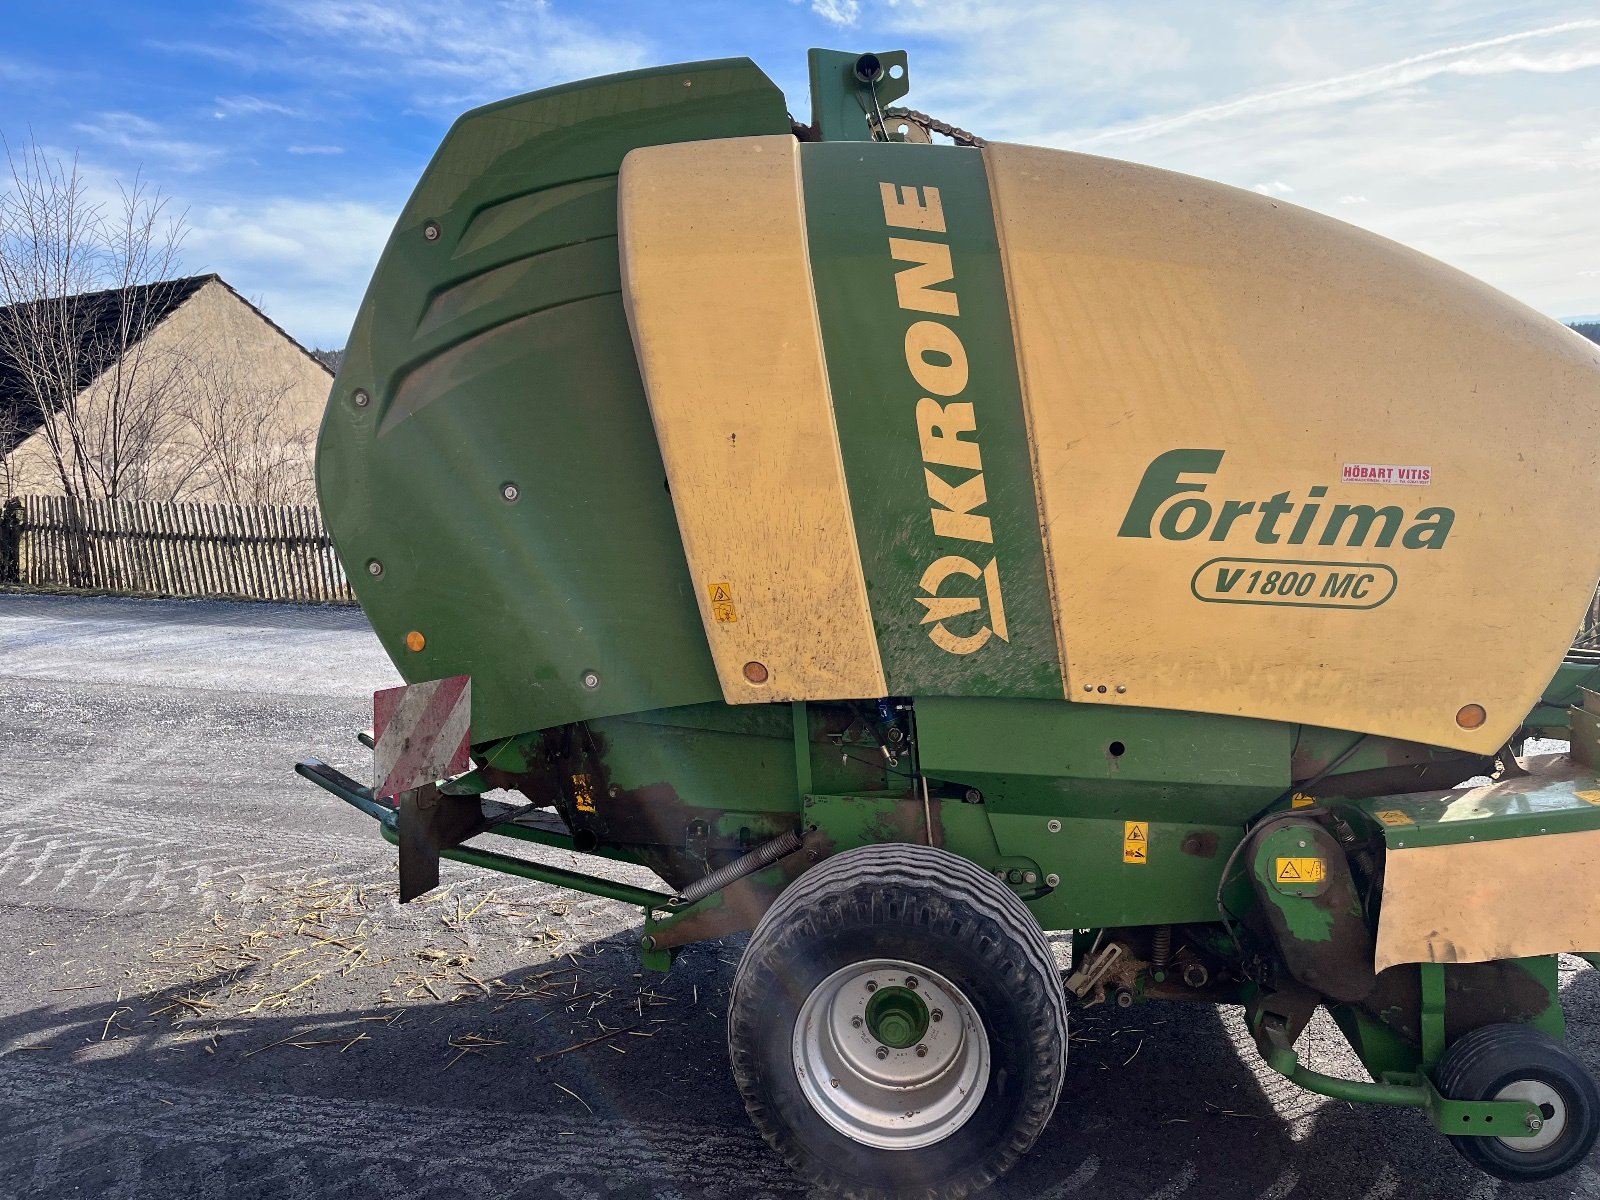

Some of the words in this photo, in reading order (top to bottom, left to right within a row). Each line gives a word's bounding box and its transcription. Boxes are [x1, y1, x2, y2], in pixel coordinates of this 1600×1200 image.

[879, 181, 994, 544] KRONE
[1116, 448, 1456, 550] Fortima
[1343, 465, 1394, 479] HÖBART
[1398, 468, 1430, 480] VITIS
[1215, 567, 1246, 593] V
[1246, 570, 1317, 597] 1800
[1319, 572, 1375, 599] MC
